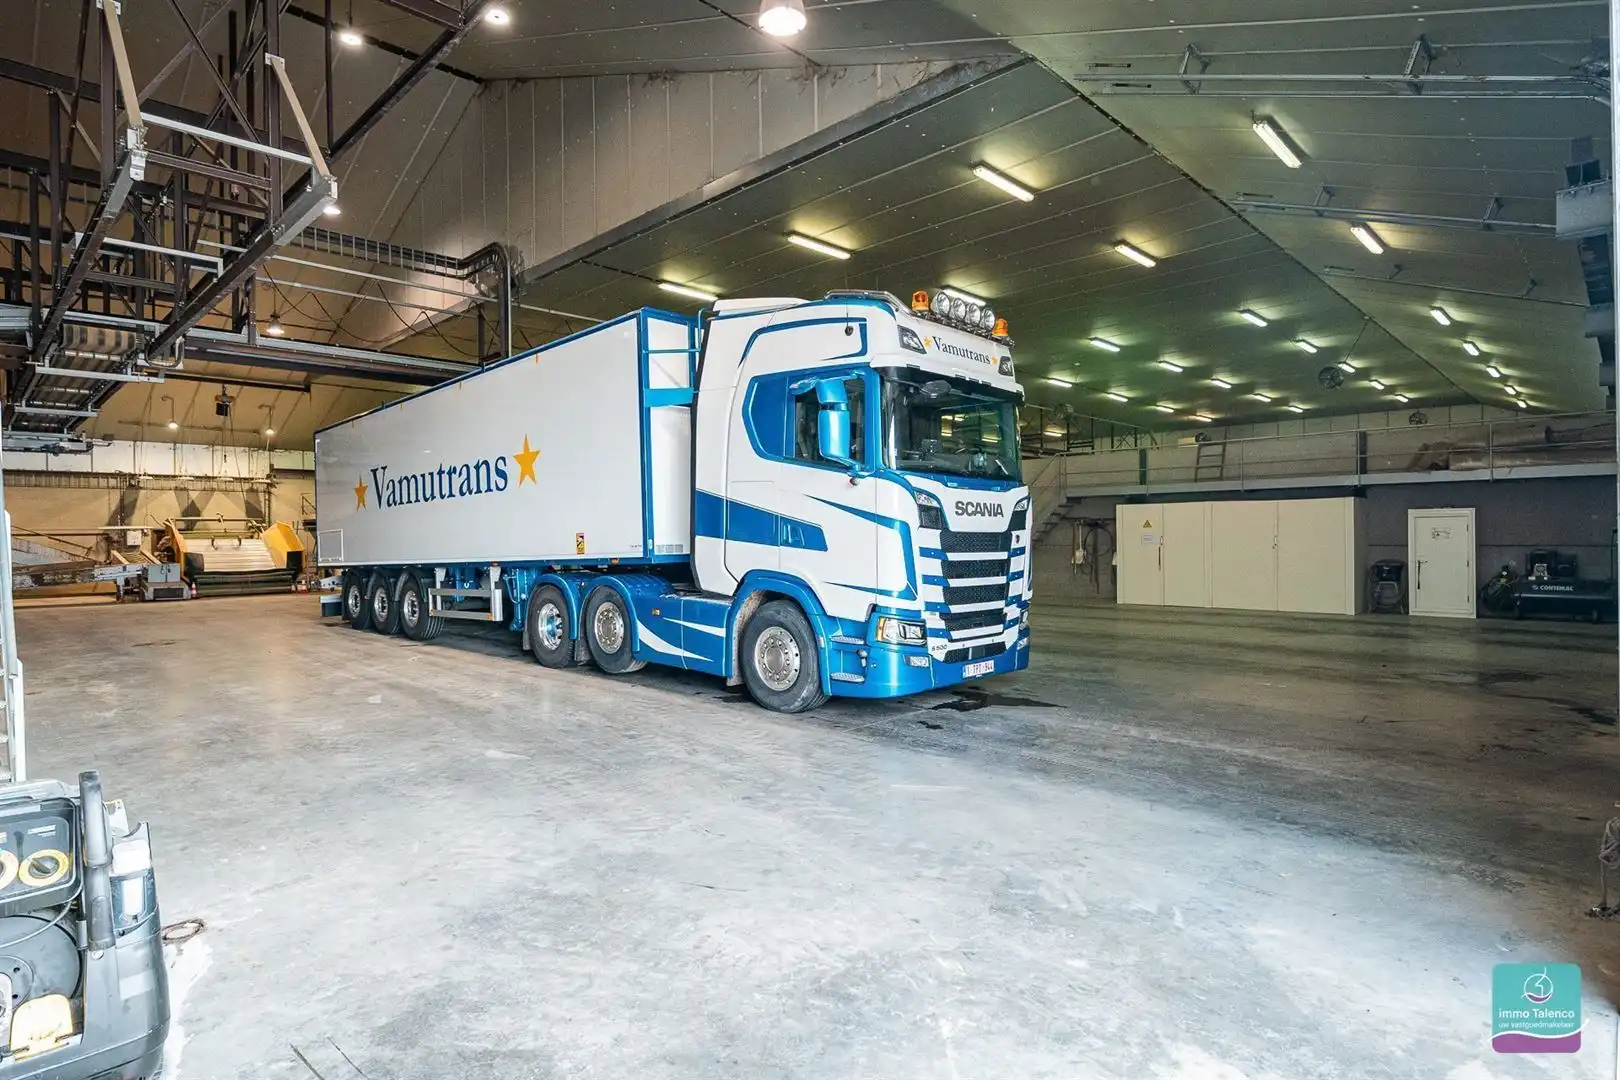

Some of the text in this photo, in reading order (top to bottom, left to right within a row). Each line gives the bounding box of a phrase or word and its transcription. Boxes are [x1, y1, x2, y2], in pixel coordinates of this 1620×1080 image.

[932, 336, 991, 365] Vamutrans
[370, 456, 508, 509] Vamutrans
[955, 501, 1004, 518] SCANIA
